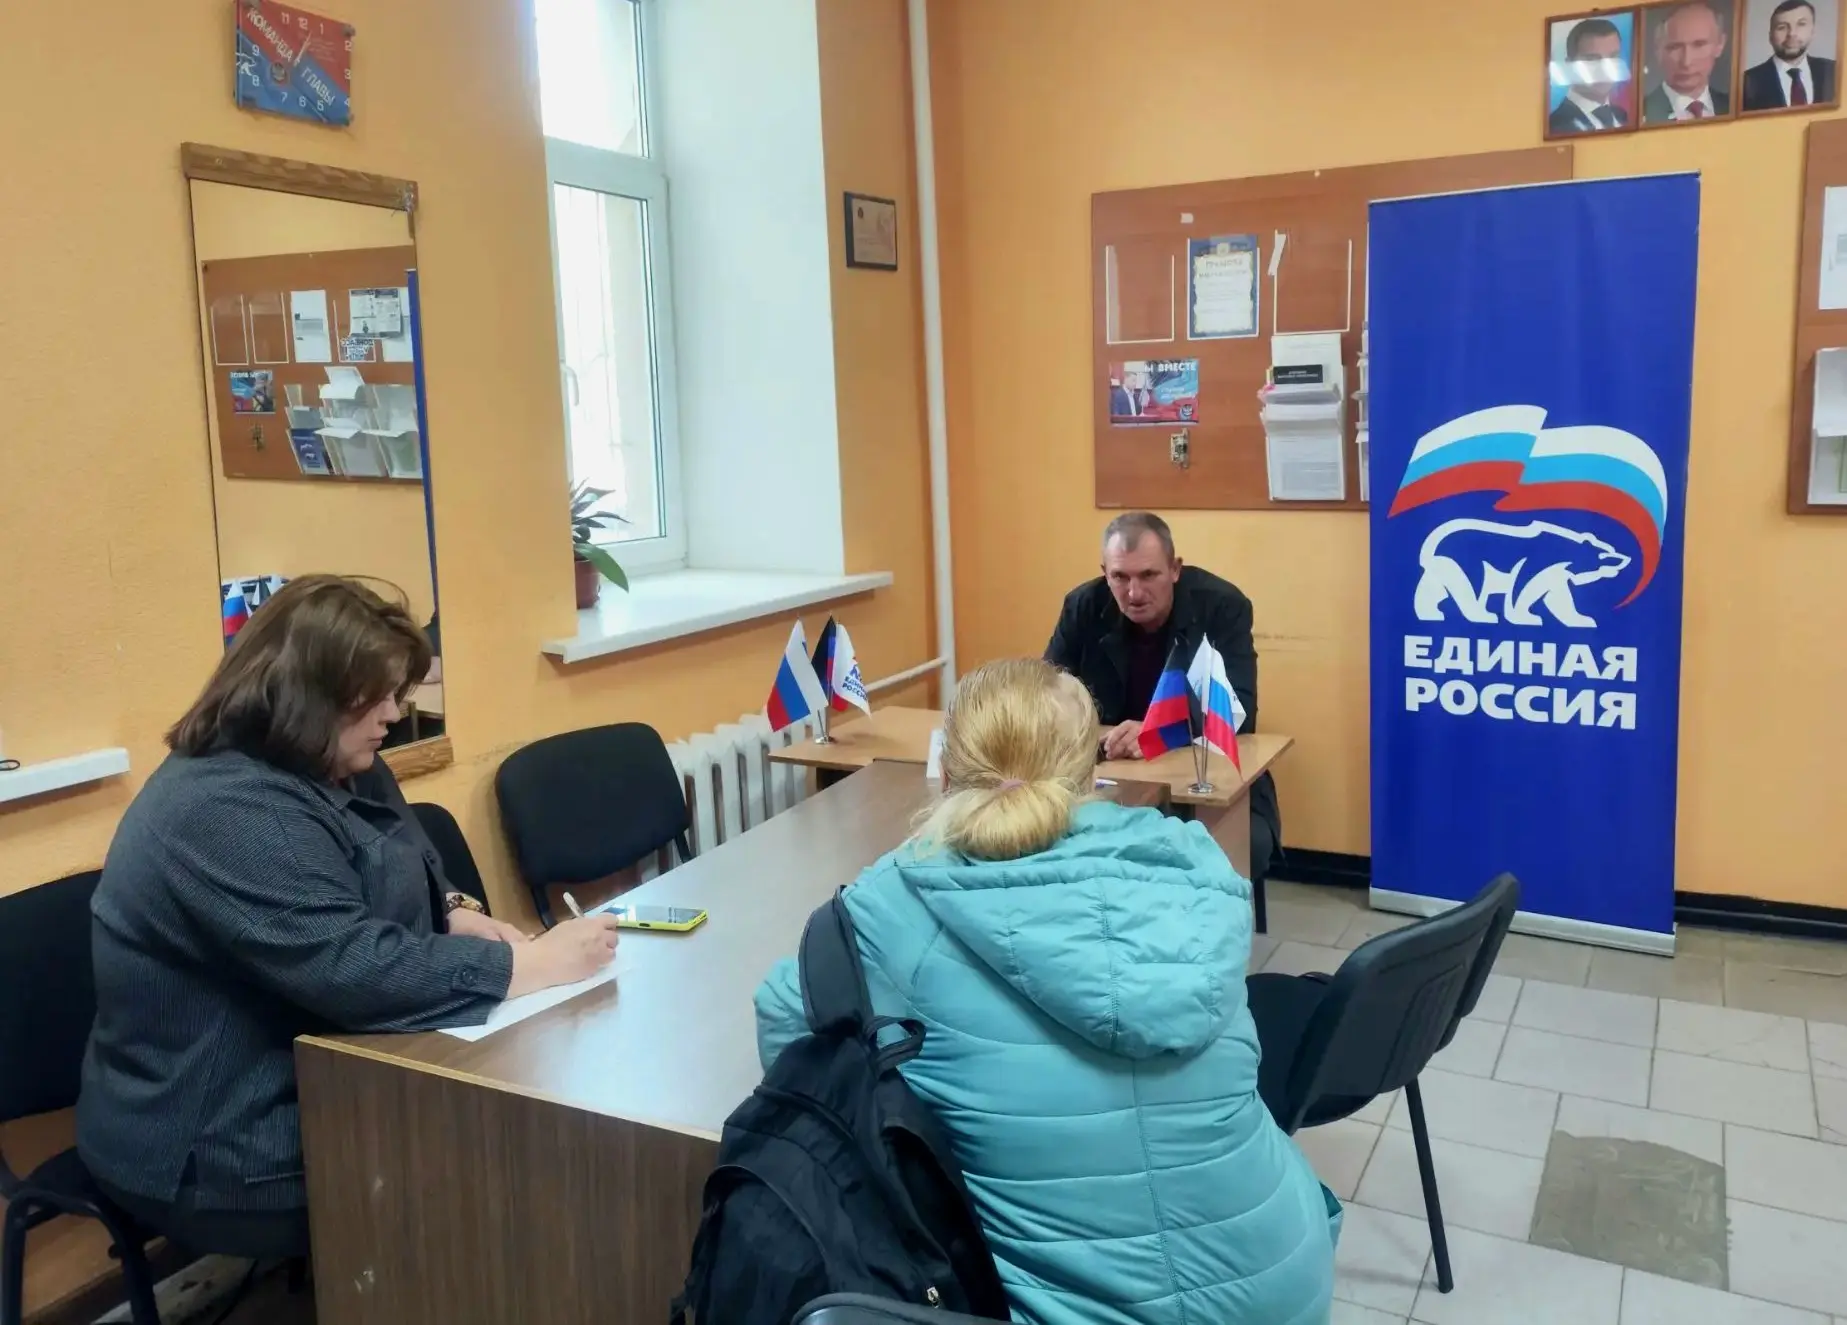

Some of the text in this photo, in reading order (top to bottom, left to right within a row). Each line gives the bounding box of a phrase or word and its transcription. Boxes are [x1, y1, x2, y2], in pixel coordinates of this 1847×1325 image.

[281, 12, 290, 24] 11
[298, 17, 308, 30] 12
[319, 23, 324, 35] 1
[252, 44, 260, 56] 9
[344, 40, 352, 51] 2
[344, 68, 351, 80] 3
[252, 75, 260, 87] 8
[301, 66, 336, 106] ГЛАВЫ
[281, 92, 288, 104] 7
[298, 95, 306, 108] 6
[1158, 362, 1197, 373] ВМЕСТЕ
[1404, 634, 1638, 682] ЕДИНАЯ
[1405, 677, 1637, 730] РОССИЯ
